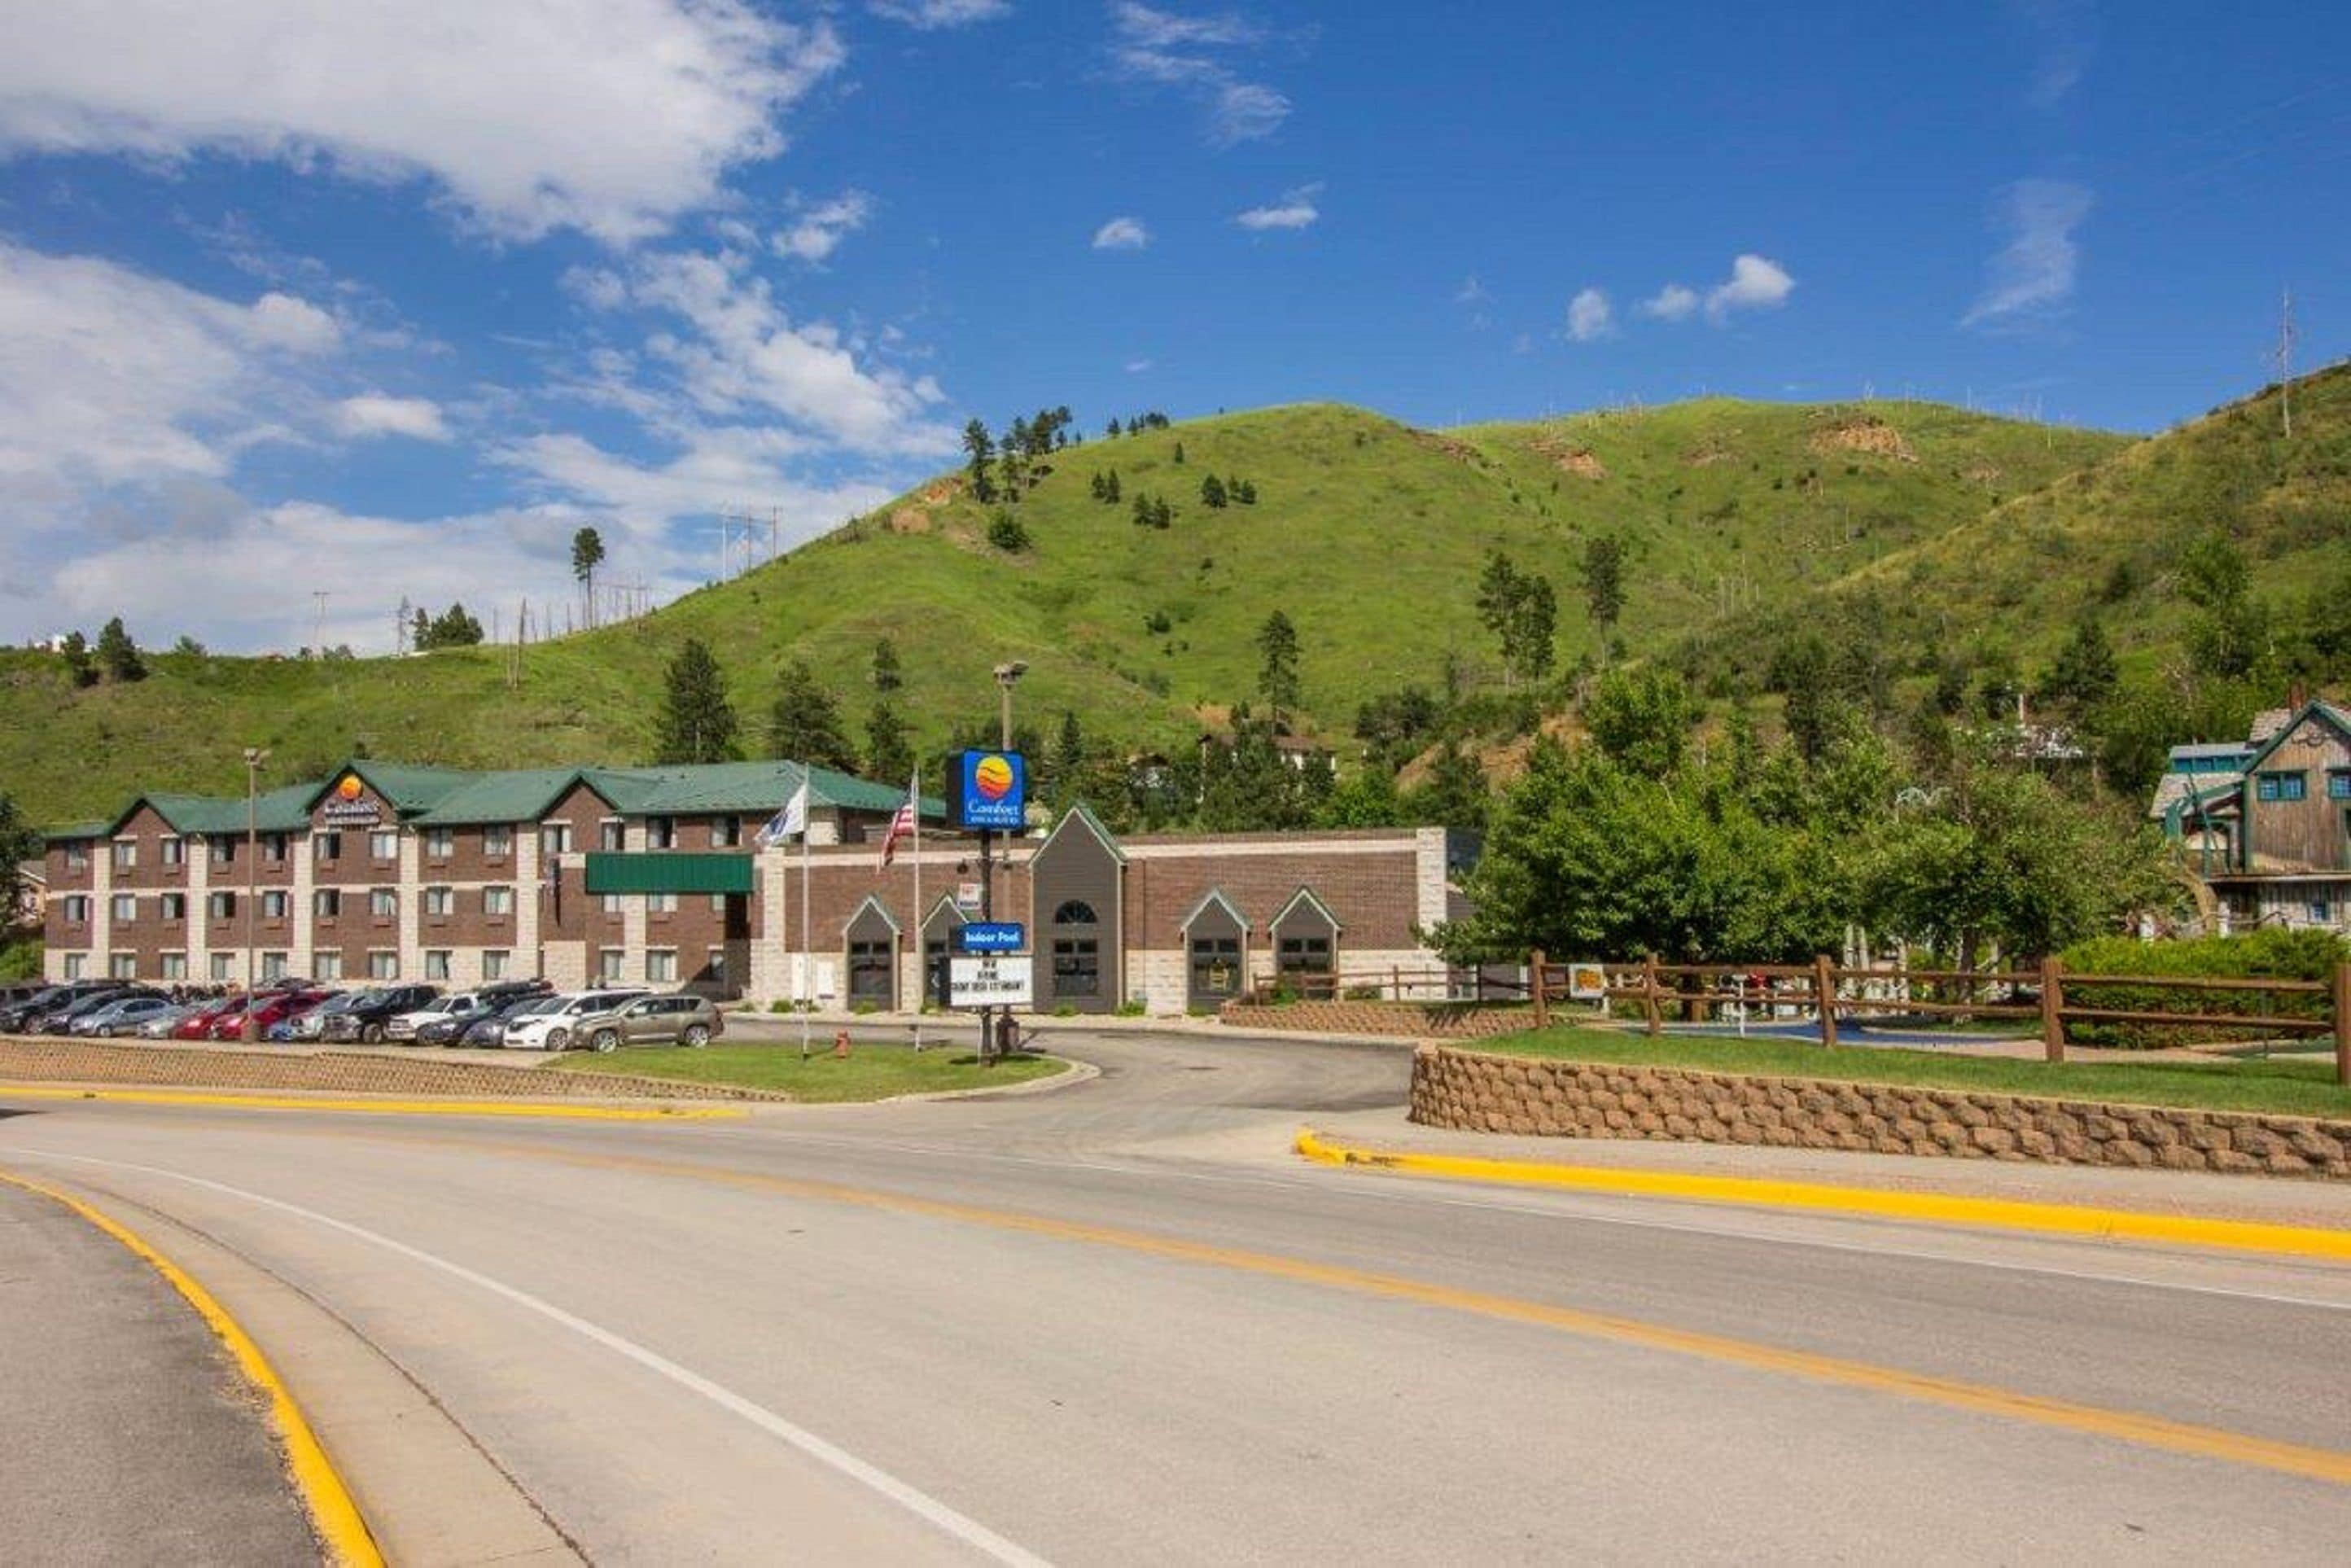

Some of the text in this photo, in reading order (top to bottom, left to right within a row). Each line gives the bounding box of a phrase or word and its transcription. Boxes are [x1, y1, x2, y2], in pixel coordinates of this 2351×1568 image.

[969, 799, 1018, 815] Comfort
[965, 931, 1020, 943] Indoor Pool
